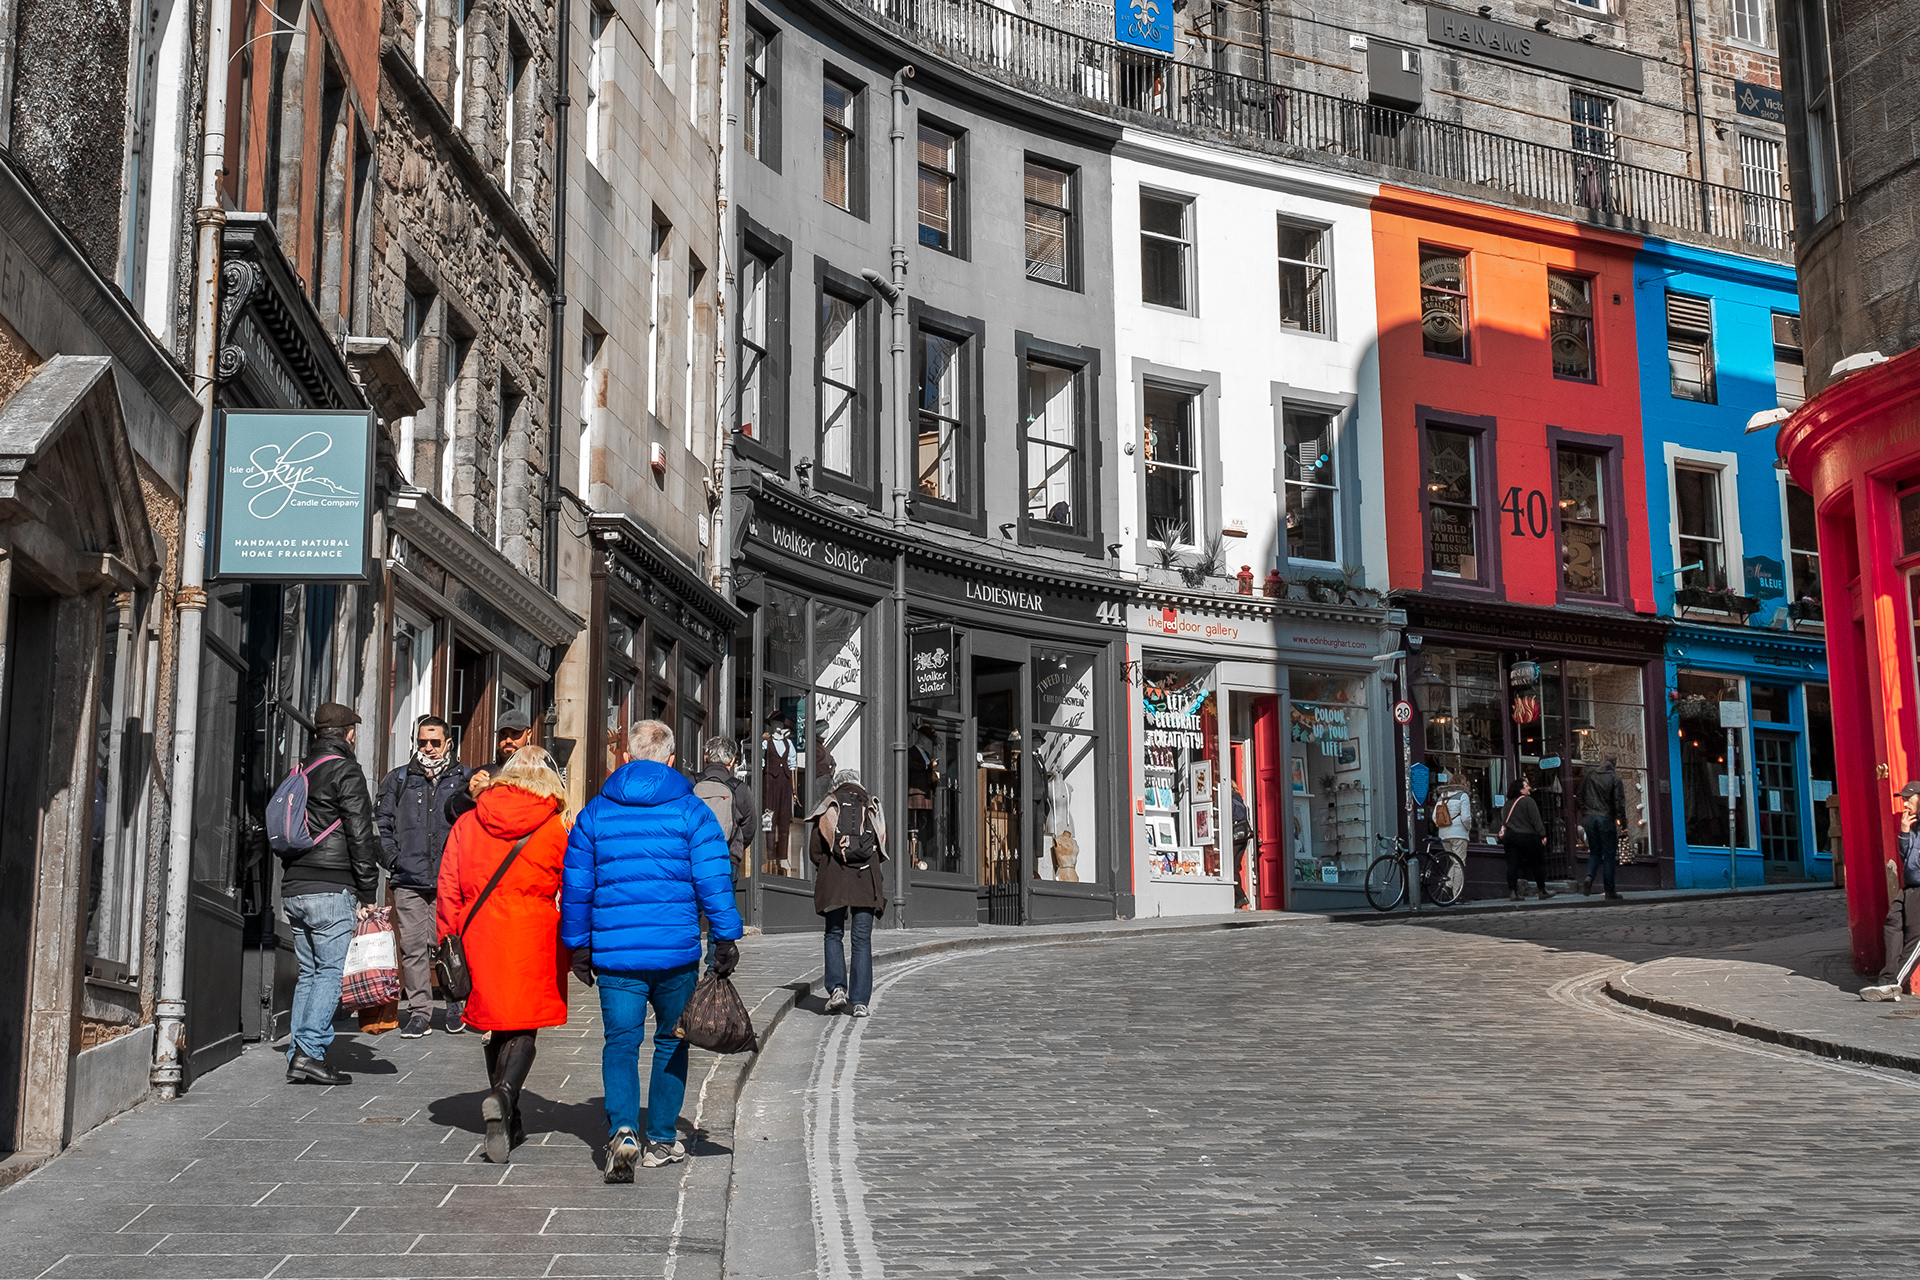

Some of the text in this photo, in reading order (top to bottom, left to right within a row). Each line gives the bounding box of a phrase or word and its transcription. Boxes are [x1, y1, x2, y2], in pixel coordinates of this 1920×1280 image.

[1442, 16, 1532, 57] HANAMS
[1760, 110, 1779, 121] SHOP
[1425, 301, 1454, 312] QUALITY
[244, 314, 255, 344] OF
[256, 333, 275, 377] SKYE
[229, 466, 255, 474] Isle of
[242, 431, 333, 520] Skye
[290, 498, 360, 508] Candle Company
[1500, 486, 1548, 539] 40
[1432, 523, 1467, 534] WORLD
[234, 539, 350, 547] HANDMADE NATURAL
[1430, 532, 1468, 544] FAMOUS
[241, 550, 343, 558] HOME FRAGRANCE
[772, 525, 816, 558] Walker
[824, 542, 869, 574] Slater
[1760, 577, 1783, 590] BLEUE
[966, 582, 1044, 612] LADIESWEAR
[1148, 614, 1238, 640] the red door gallery
[1424, 617, 1646, 650] Retailer of Officially Licensed HARRY POTTER Merchandise
[1292, 636, 1367, 649] www.edinburghart.com
[538, 645, 551, 672] 89
[917, 671, 948, 683] Walker
[920, 682, 946, 693] Slater
[1036, 673, 1060, 698] TWEED
[1043, 694, 1085, 708] CHILDRENSWEAR
[1314, 707, 1346, 724] COLOUR
[1396, 707, 1410, 718] 20
[1155, 711, 1201, 730] CELEBRATE
[1312, 724, 1350, 741] UP YOUR
[1321, 741, 1343, 758] LIFE!
